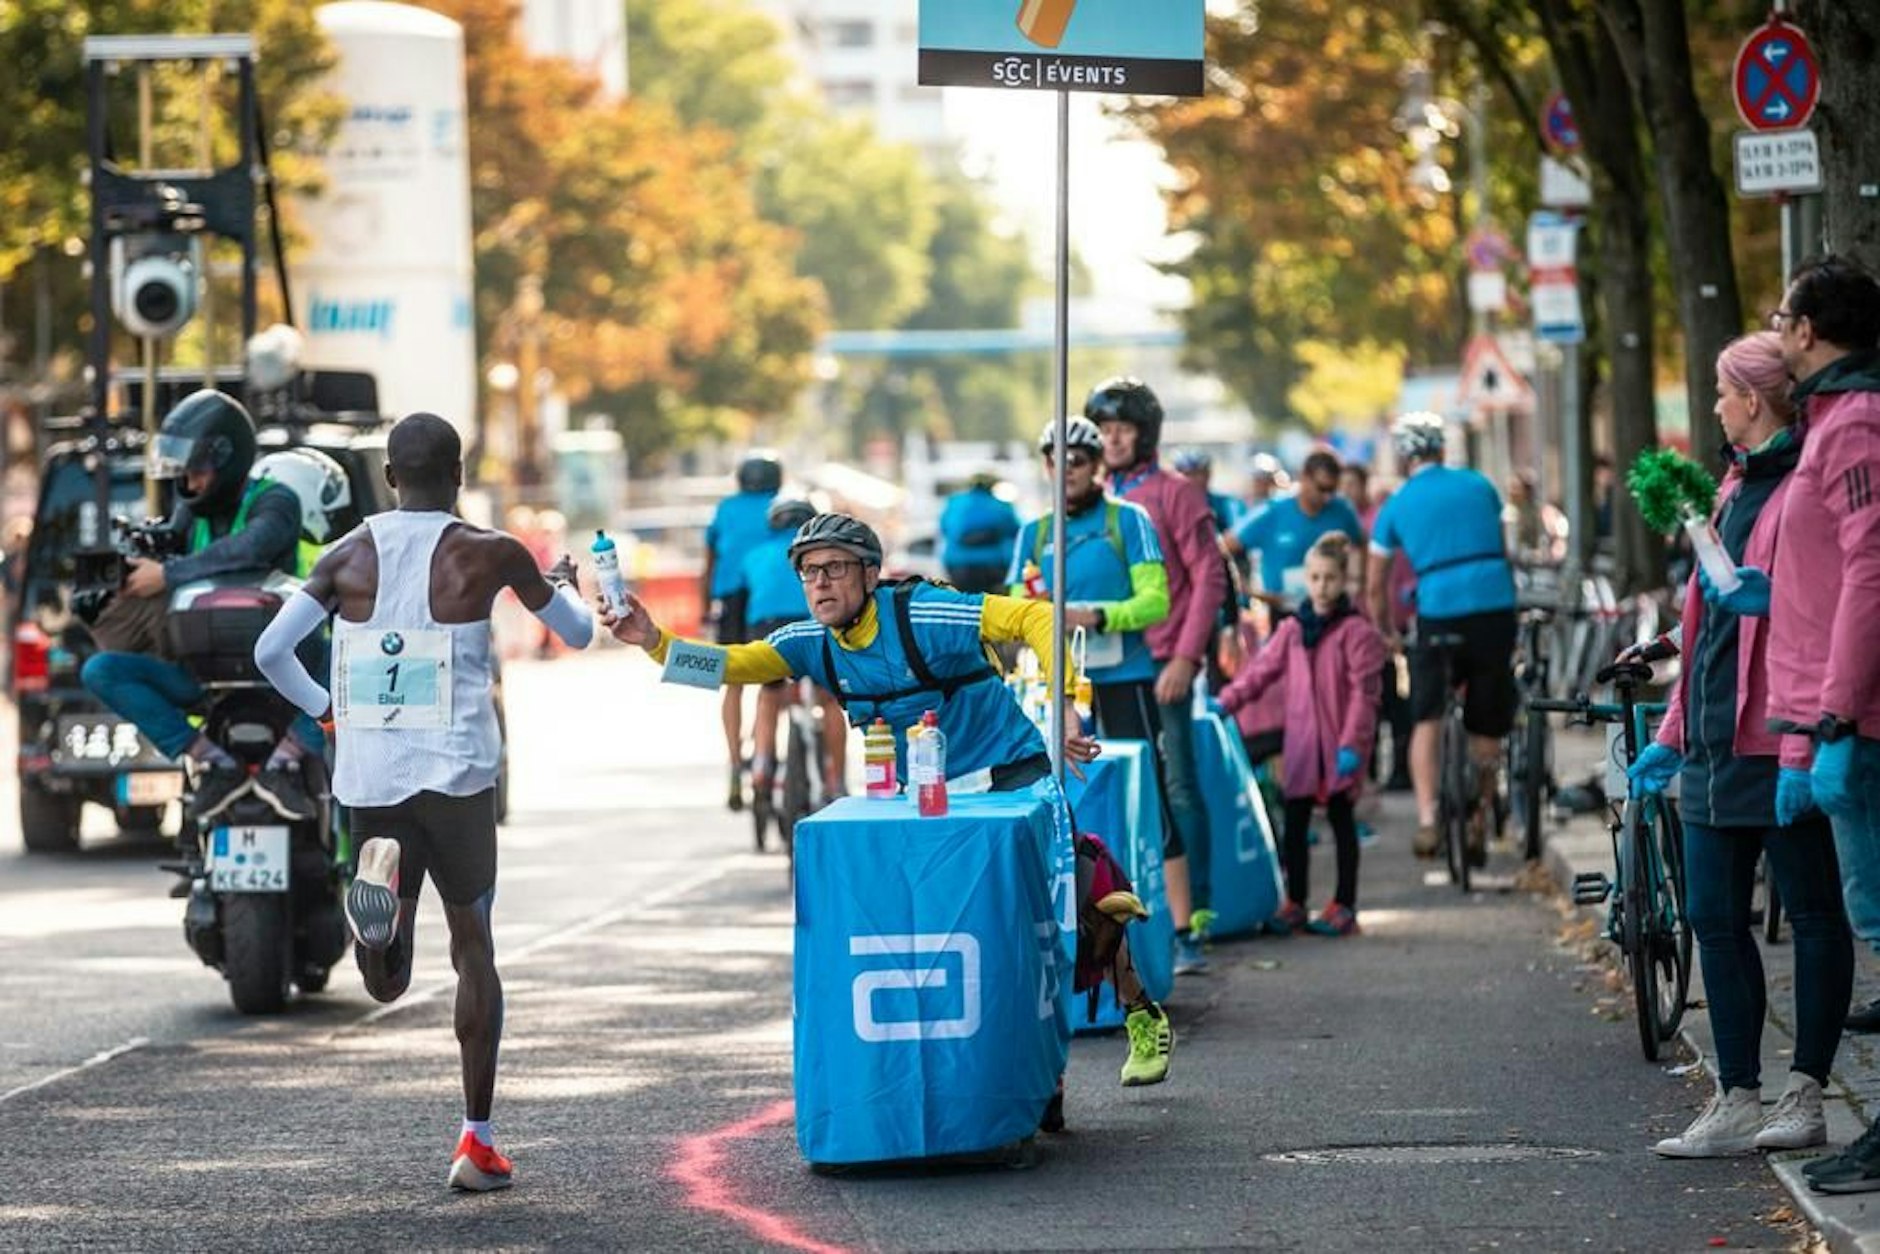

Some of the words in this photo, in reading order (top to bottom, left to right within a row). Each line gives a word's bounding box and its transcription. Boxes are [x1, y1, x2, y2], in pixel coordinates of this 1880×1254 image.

[992, 58, 1032, 85] SCC
[673, 652, 720, 672] KIPCHOGE
[386, 662, 400, 693] 1
[242, 829, 256, 848] M
[215, 869, 242, 889] KE
[246, 869, 284, 888] 424
